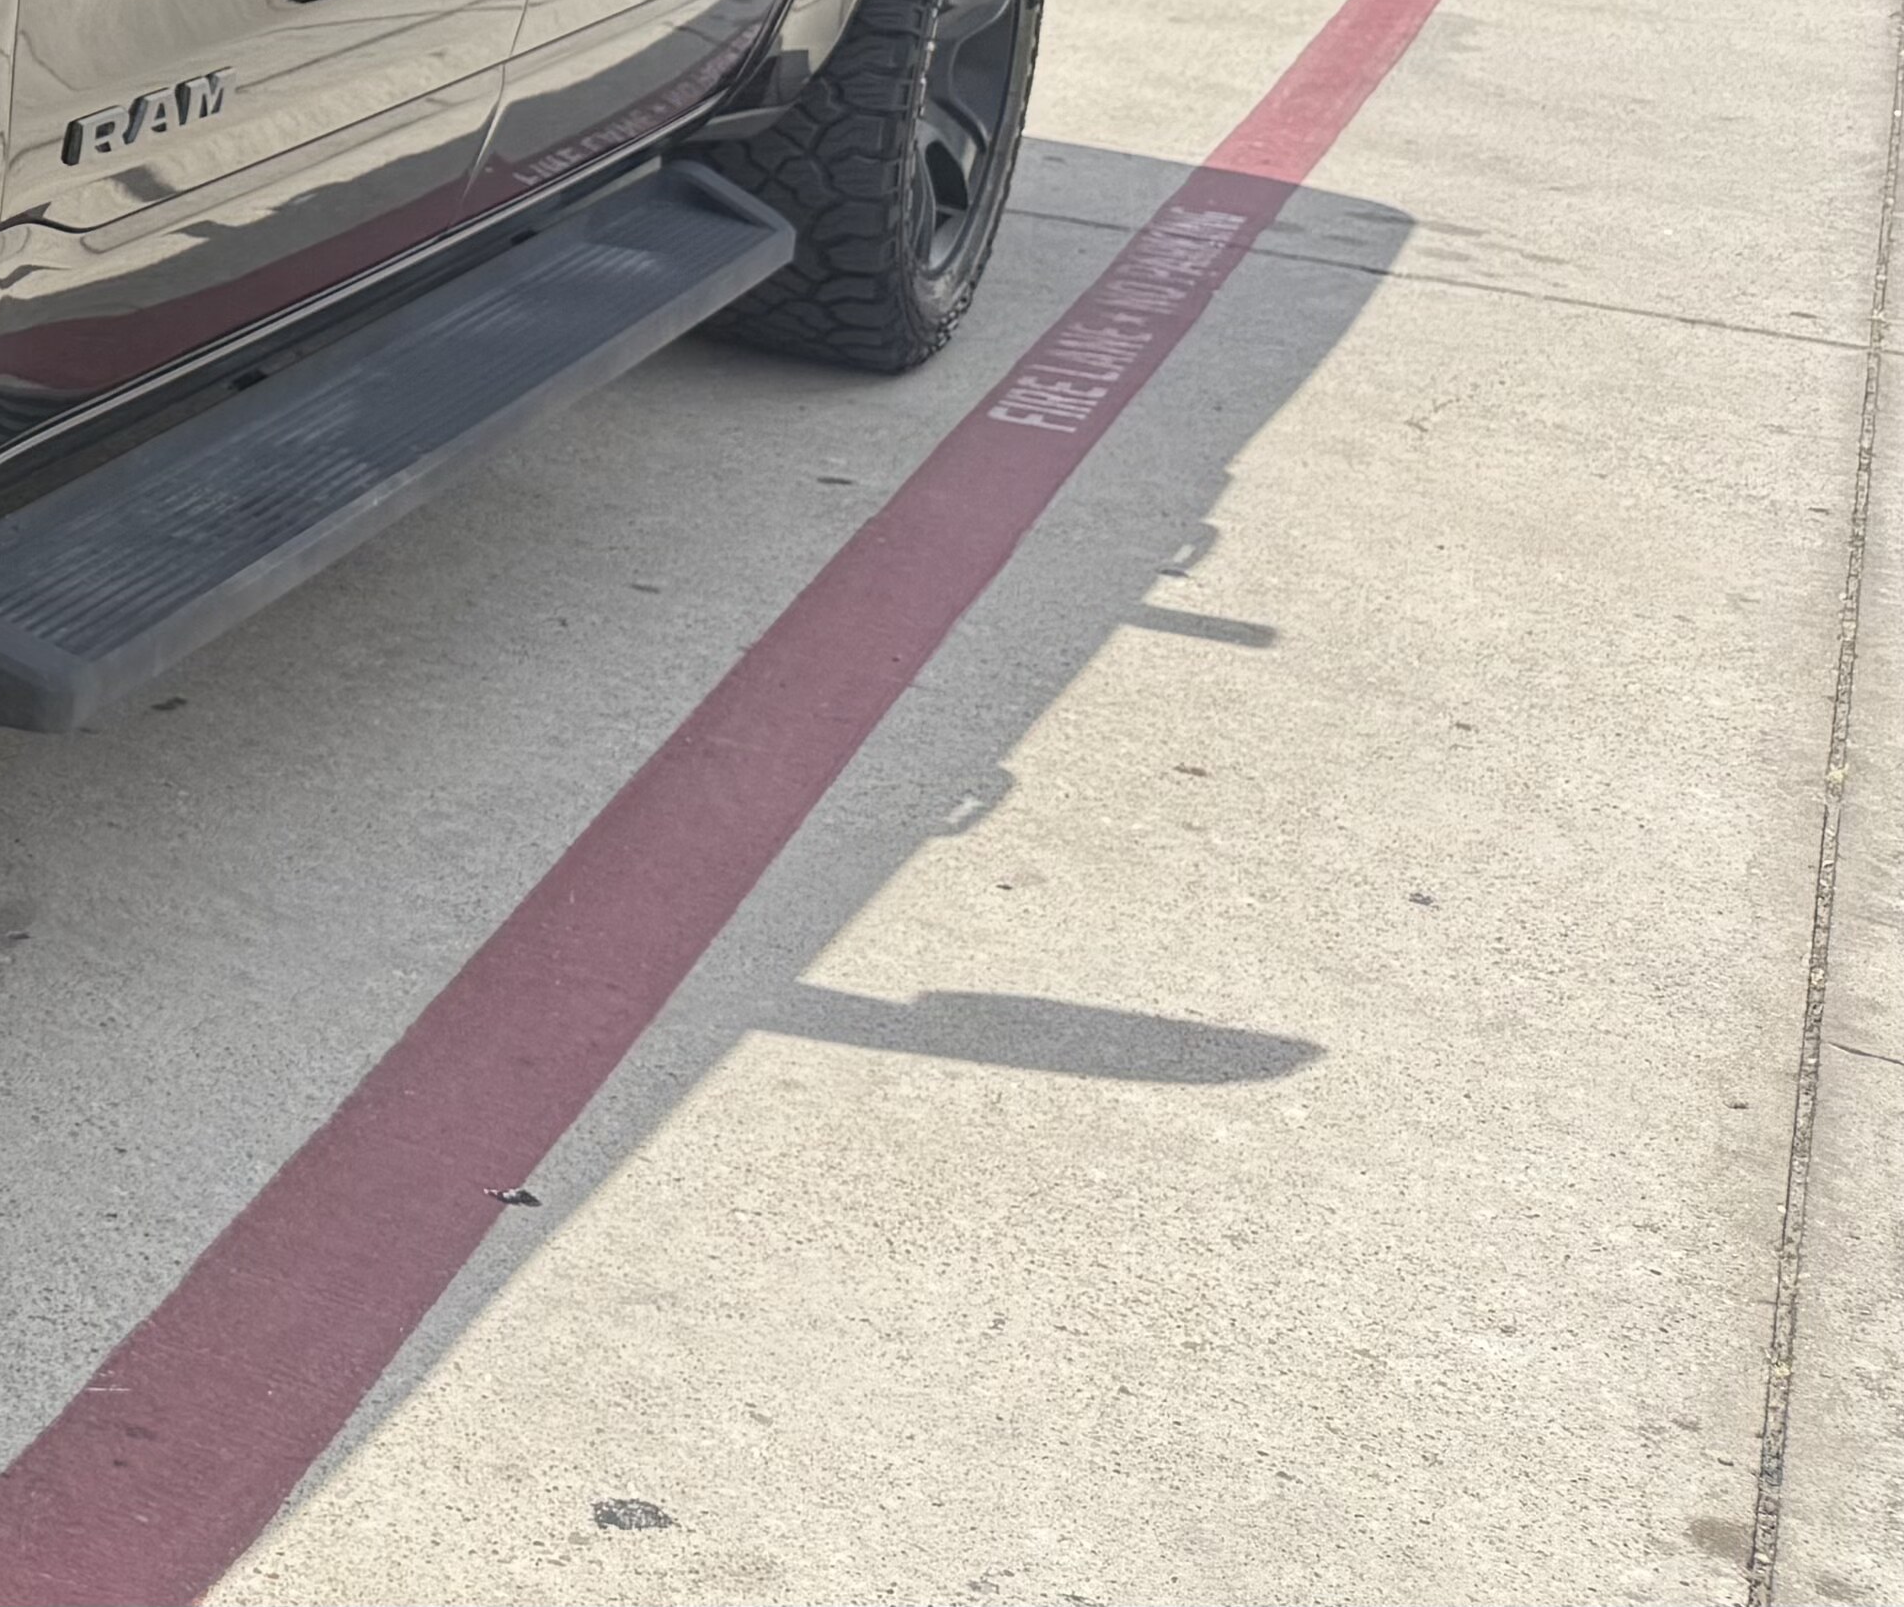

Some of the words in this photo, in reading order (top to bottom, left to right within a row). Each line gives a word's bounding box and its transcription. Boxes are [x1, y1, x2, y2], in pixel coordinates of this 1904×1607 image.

[60, 65, 238, 167] RAM
[1094, 280, 1188, 315] NO
[1025, 322, 1153, 382] LANE
[987, 375, 1109, 433] FIRE
